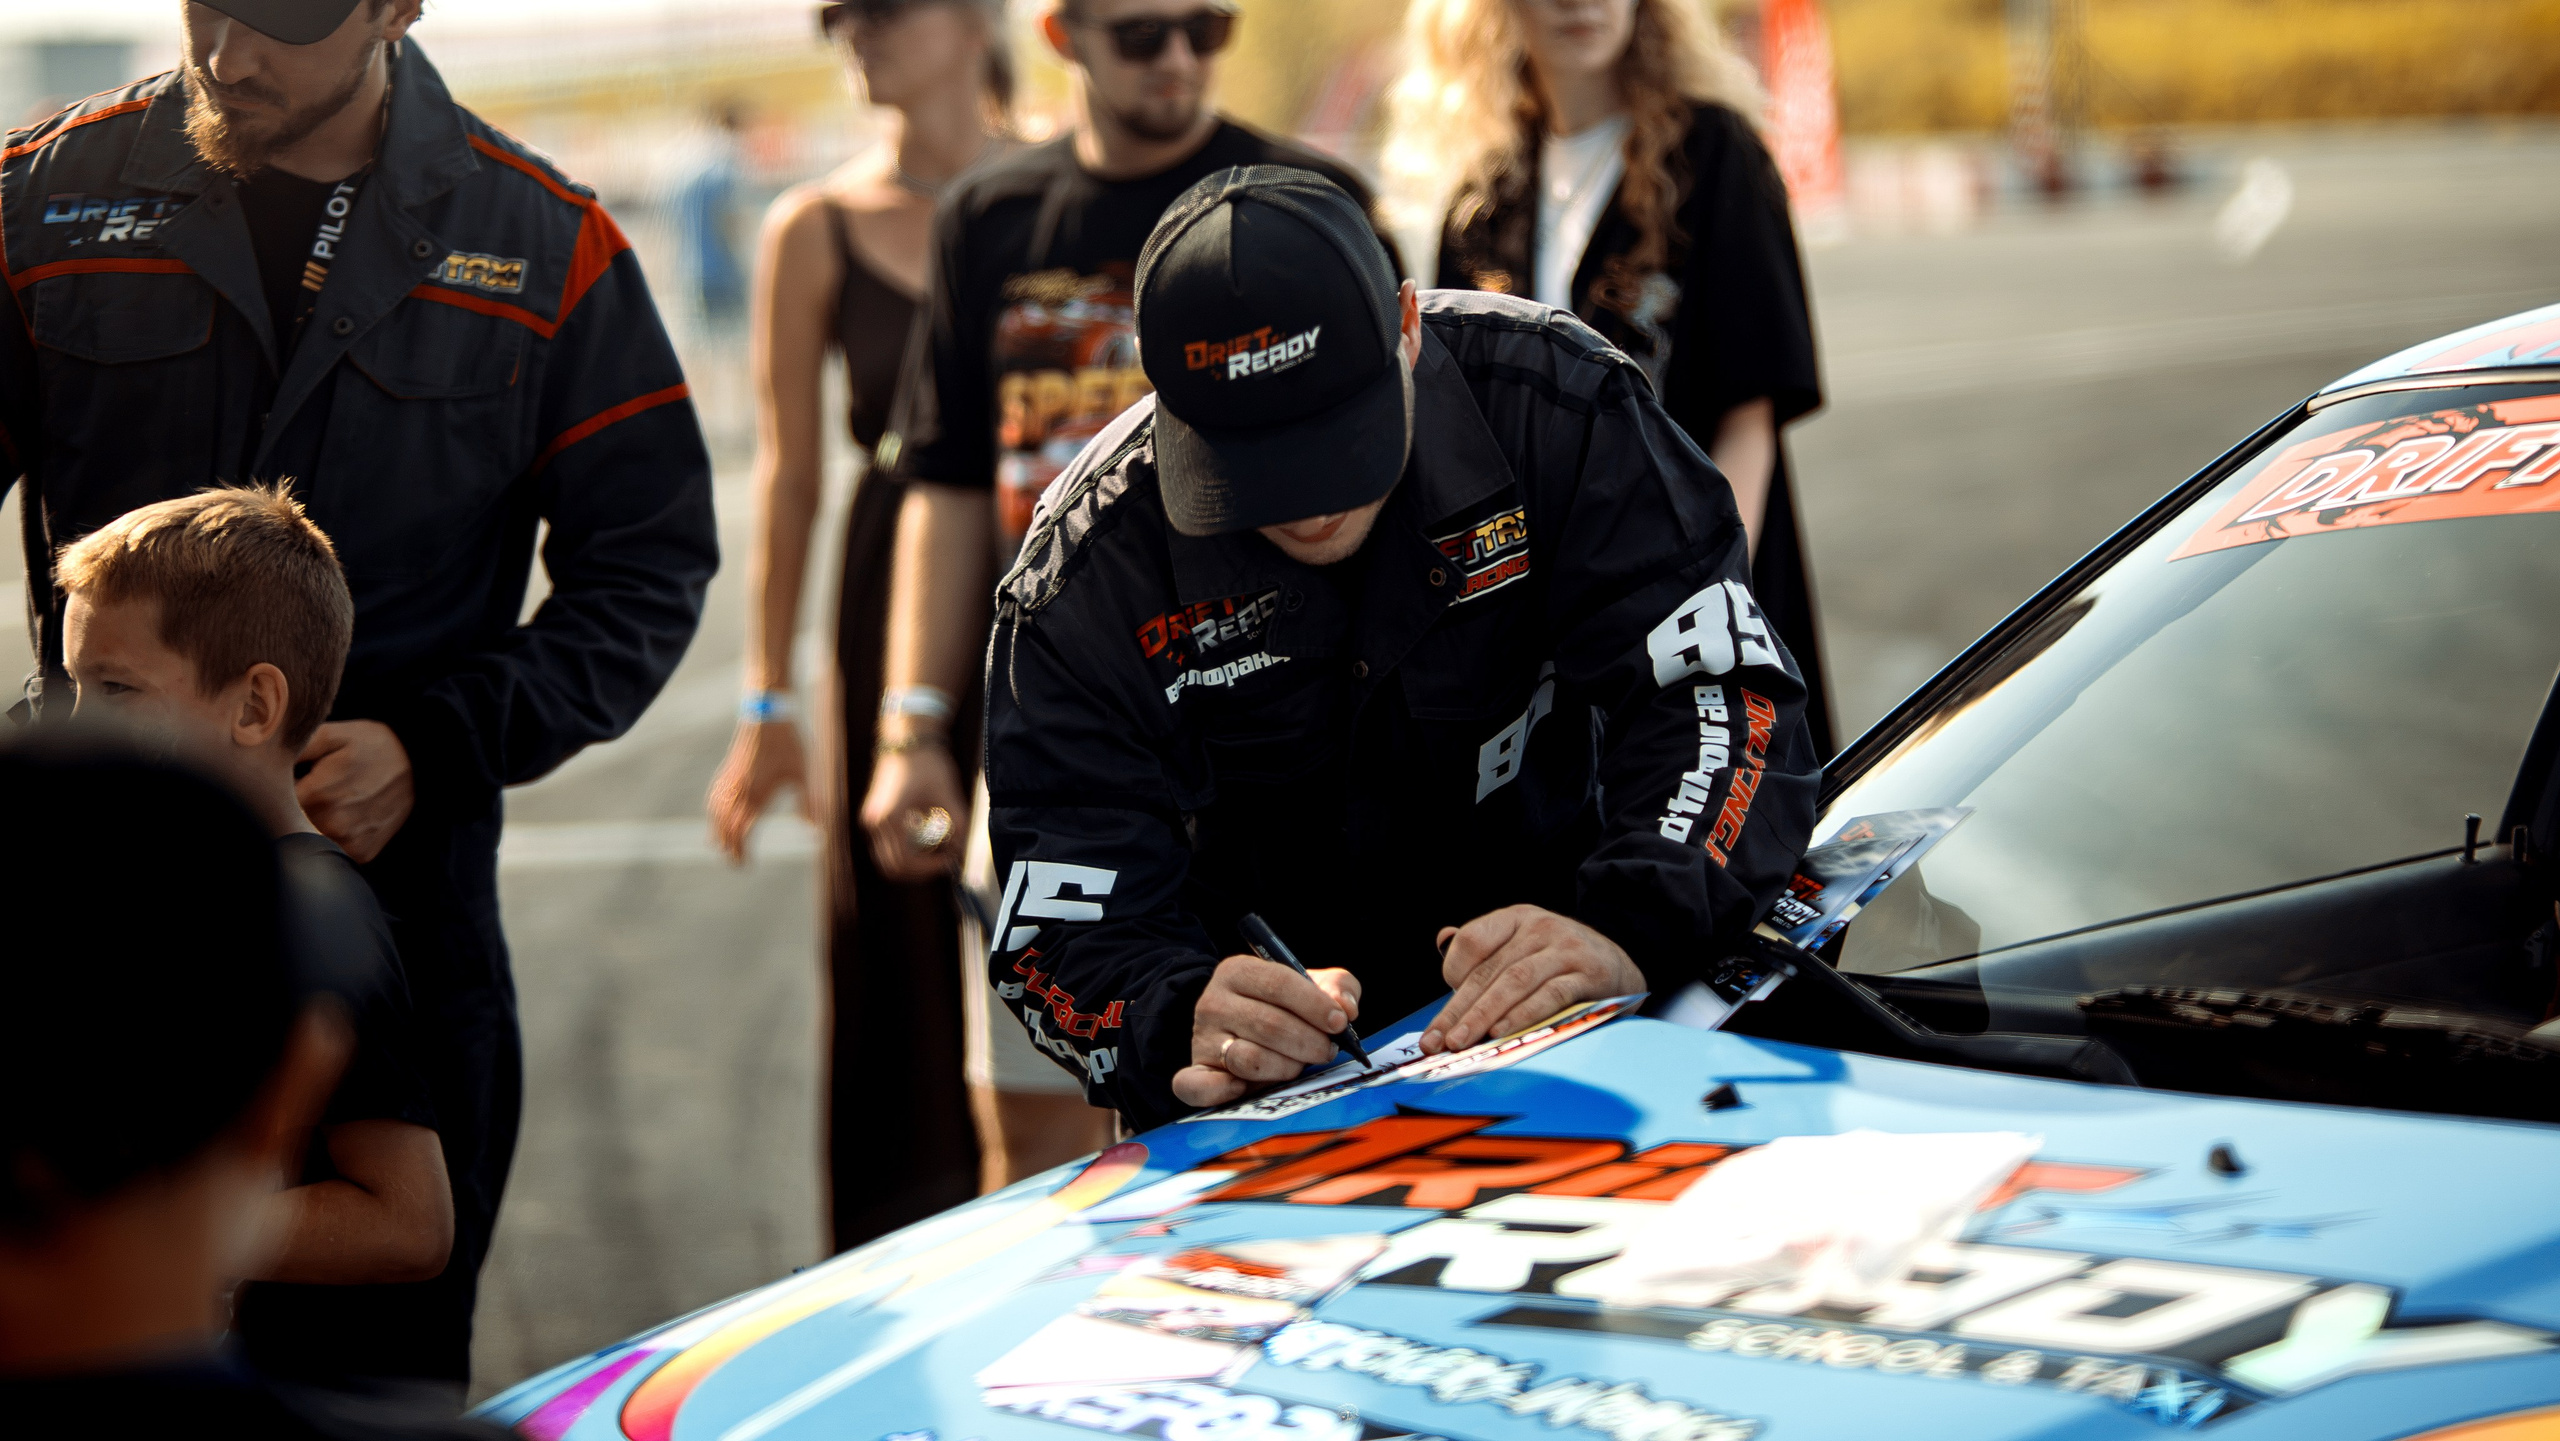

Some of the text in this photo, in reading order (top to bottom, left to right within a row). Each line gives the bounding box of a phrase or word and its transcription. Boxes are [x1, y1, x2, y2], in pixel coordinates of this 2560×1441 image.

[312, 182, 355, 260] PILOT
[445, 253, 526, 290] TAXI
[1184, 326, 1273, 371] DRIFT
[1228, 325, 1321, 381] READY
[1001, 368, 1153, 446] SPEE
[1459, 553, 1531, 598] ACING
[1192, 590, 1279, 654] READ
[1647, 577, 1785, 689] 85
[1685, 1318, 1971, 1378] SCHOOL
